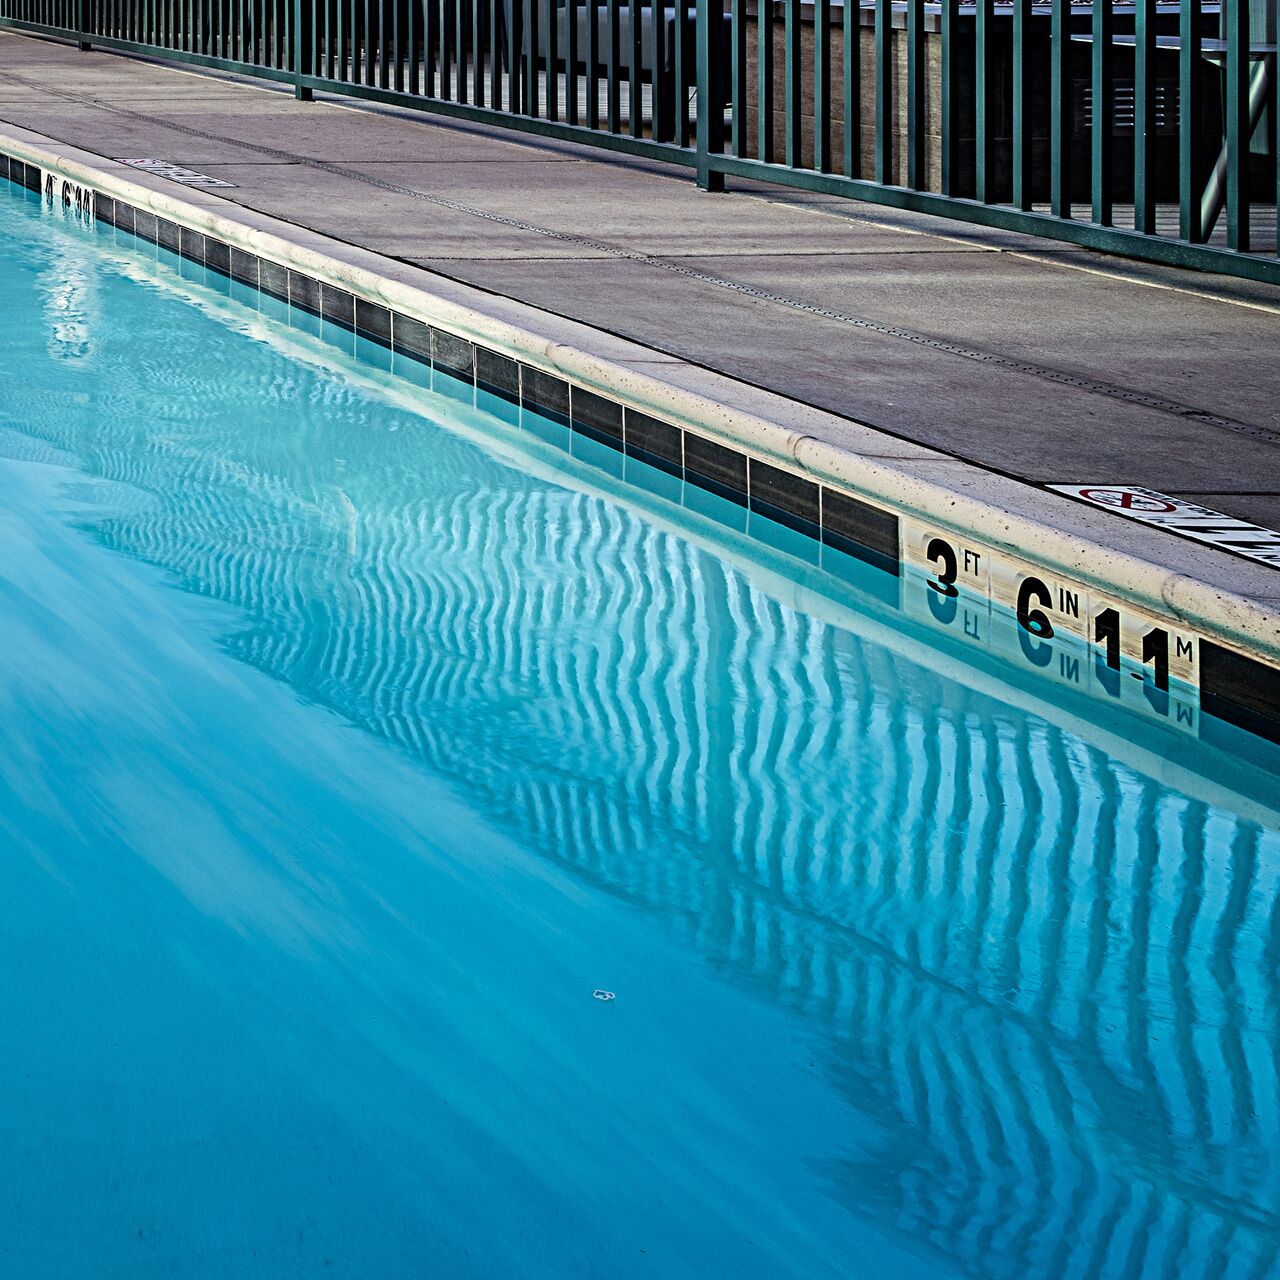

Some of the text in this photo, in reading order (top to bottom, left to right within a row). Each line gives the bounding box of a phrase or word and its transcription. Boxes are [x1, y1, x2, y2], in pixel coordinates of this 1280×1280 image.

[926, 538, 959, 606] 3
[964, 548, 981, 576] FT
[1016, 576, 1054, 648] 6
[1059, 587, 1079, 619] IN
[1176, 635, 1193, 663] M
